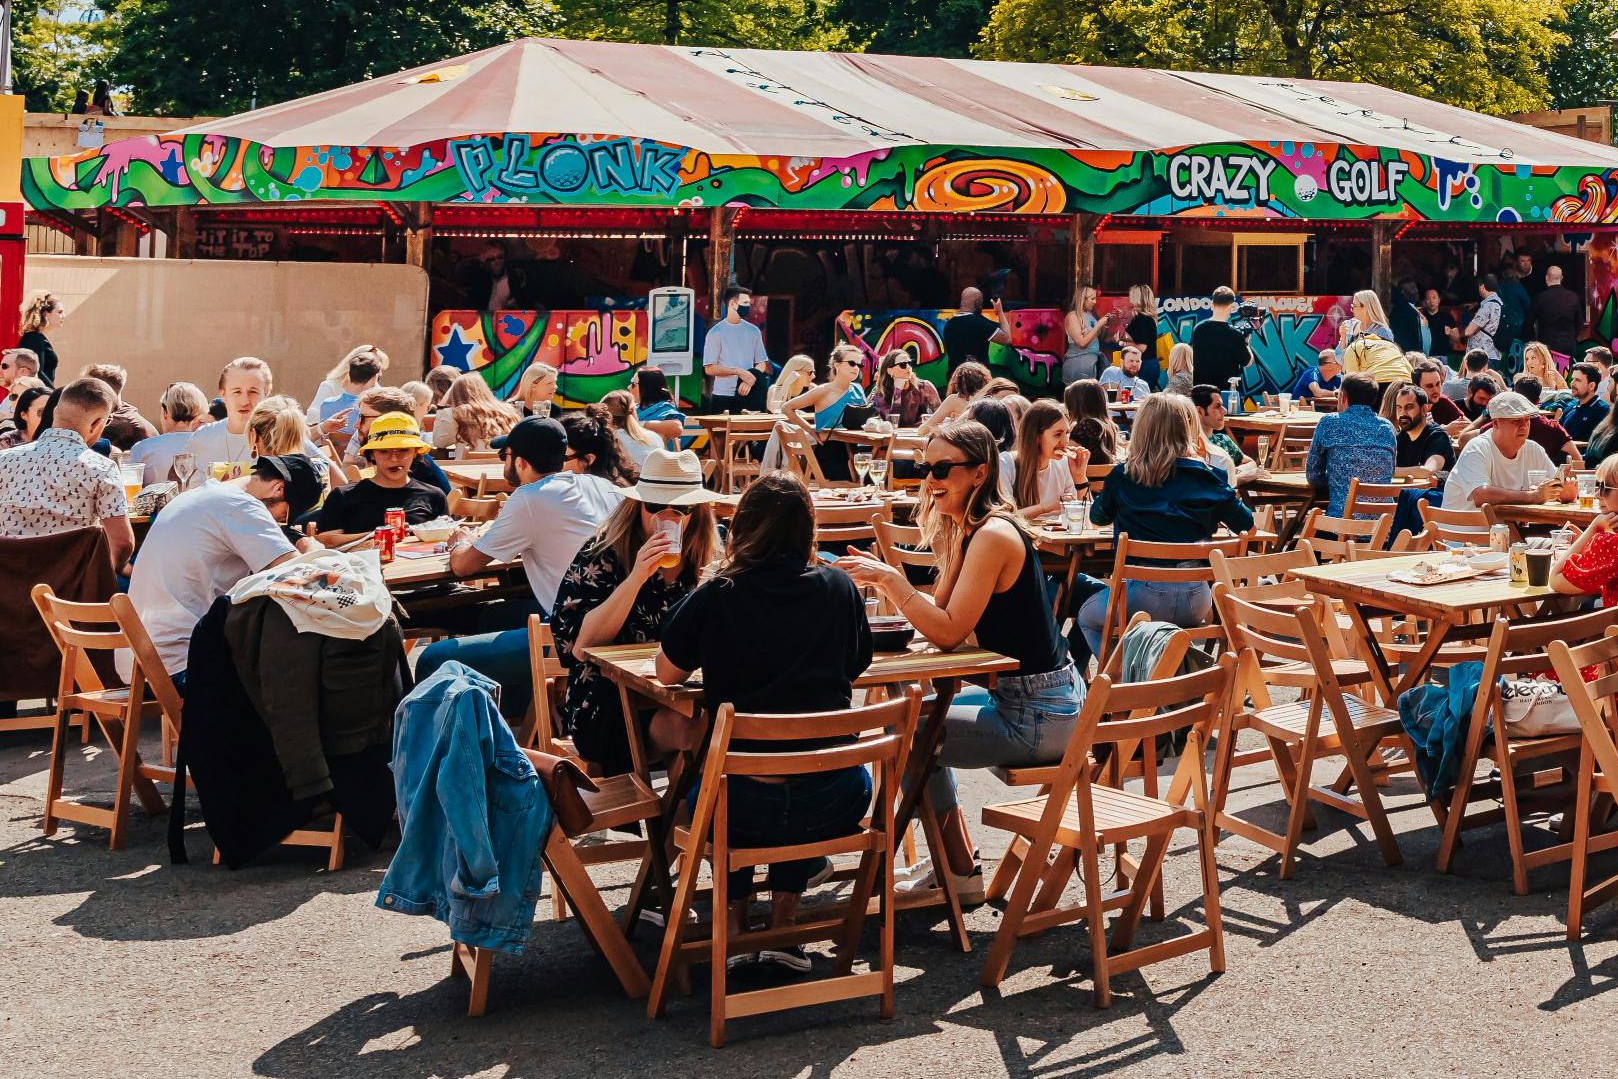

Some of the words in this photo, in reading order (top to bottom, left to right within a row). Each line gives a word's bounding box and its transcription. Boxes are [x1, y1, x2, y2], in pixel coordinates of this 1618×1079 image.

[452, 133, 684, 198] PLONK
[1168, 154, 1277, 201] CRAZY
[1328, 159, 1410, 202] GOLF
